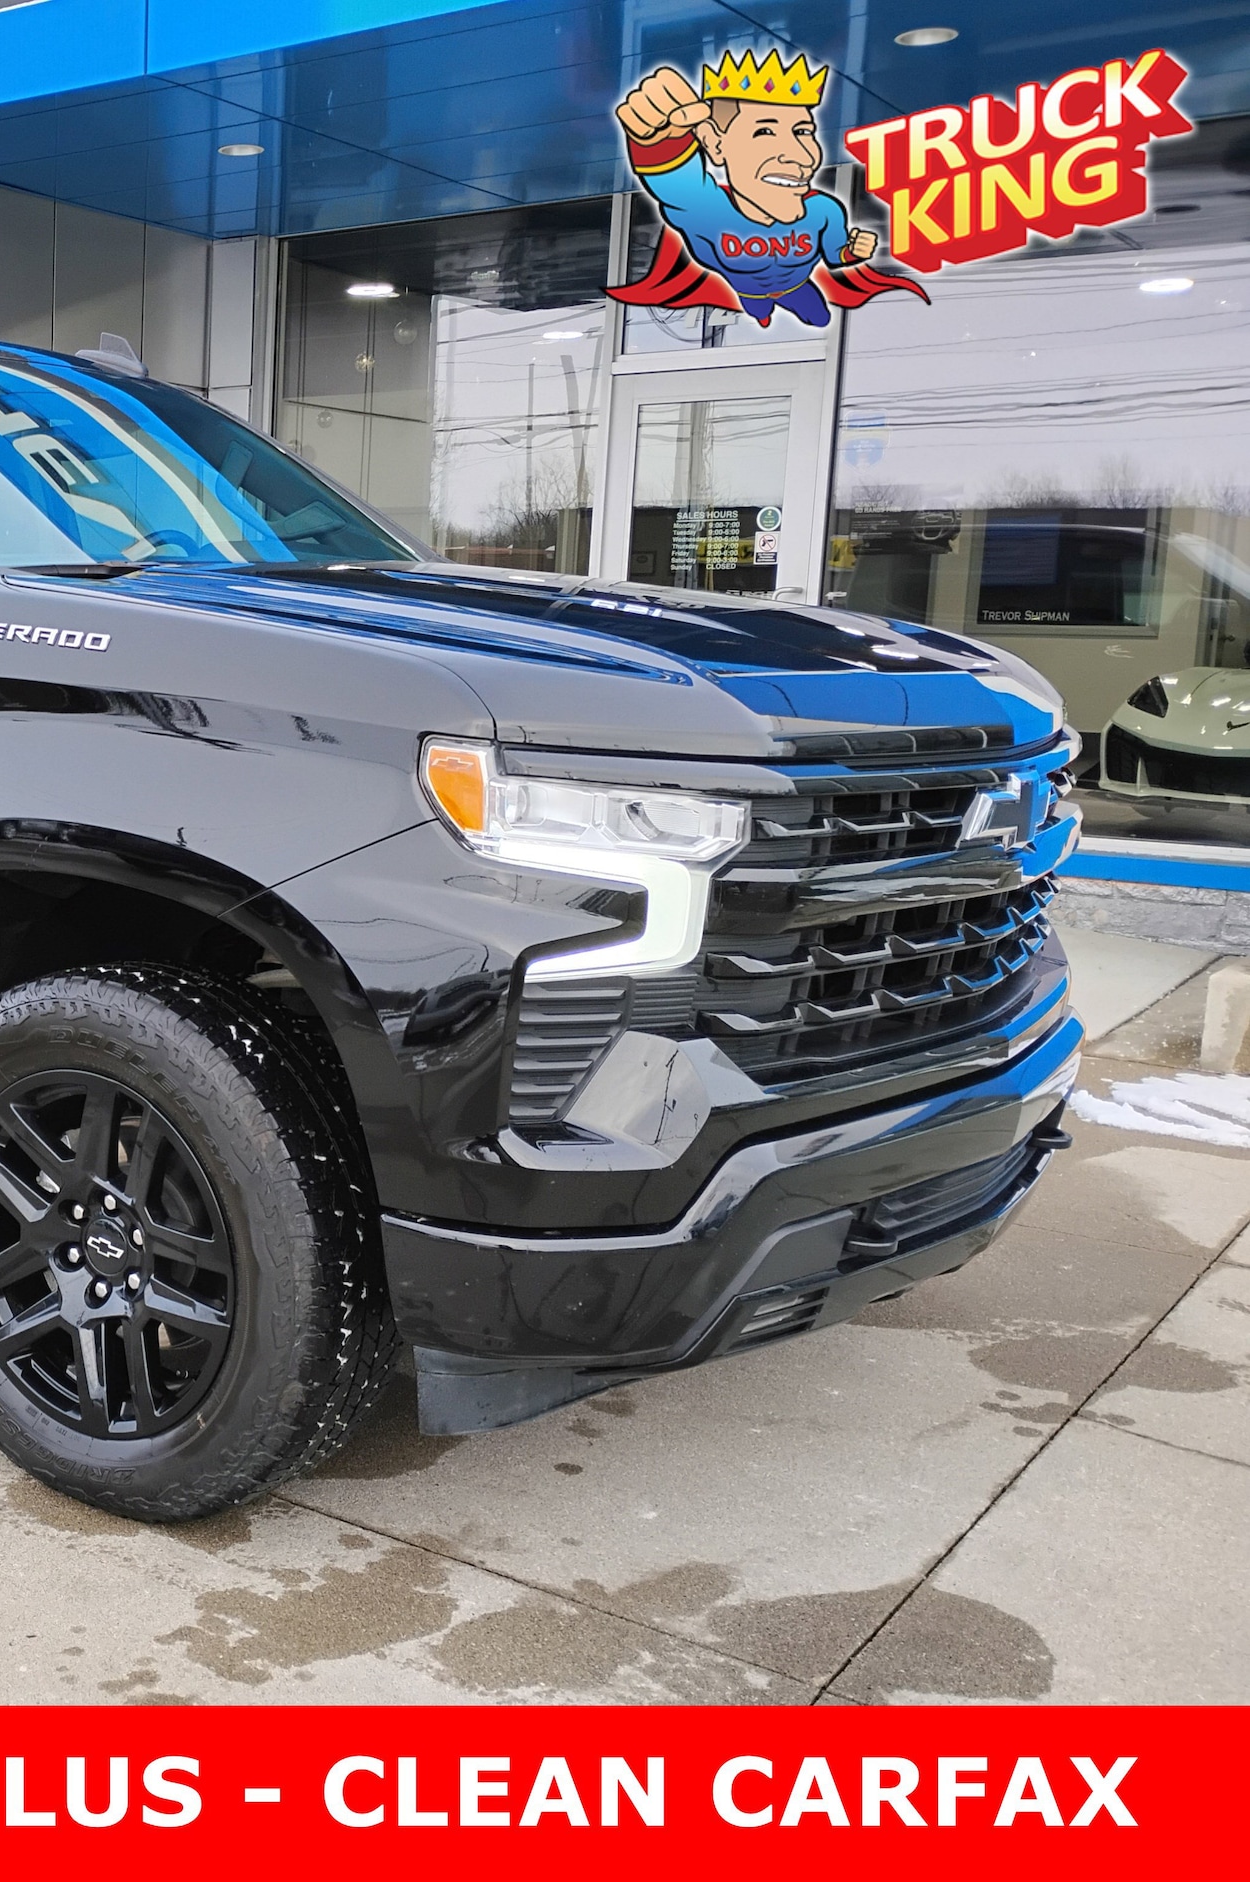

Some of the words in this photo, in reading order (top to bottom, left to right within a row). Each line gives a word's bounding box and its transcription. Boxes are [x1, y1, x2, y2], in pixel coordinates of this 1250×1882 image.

[676, 511, 705, 520] SALES
[707, 510, 739, 519] HOURS
[982, 610, 1021, 621] TREVOR
[1024, 610, 1070, 621] SHIPMAN
[47, 1025, 201, 1124] DUELER
